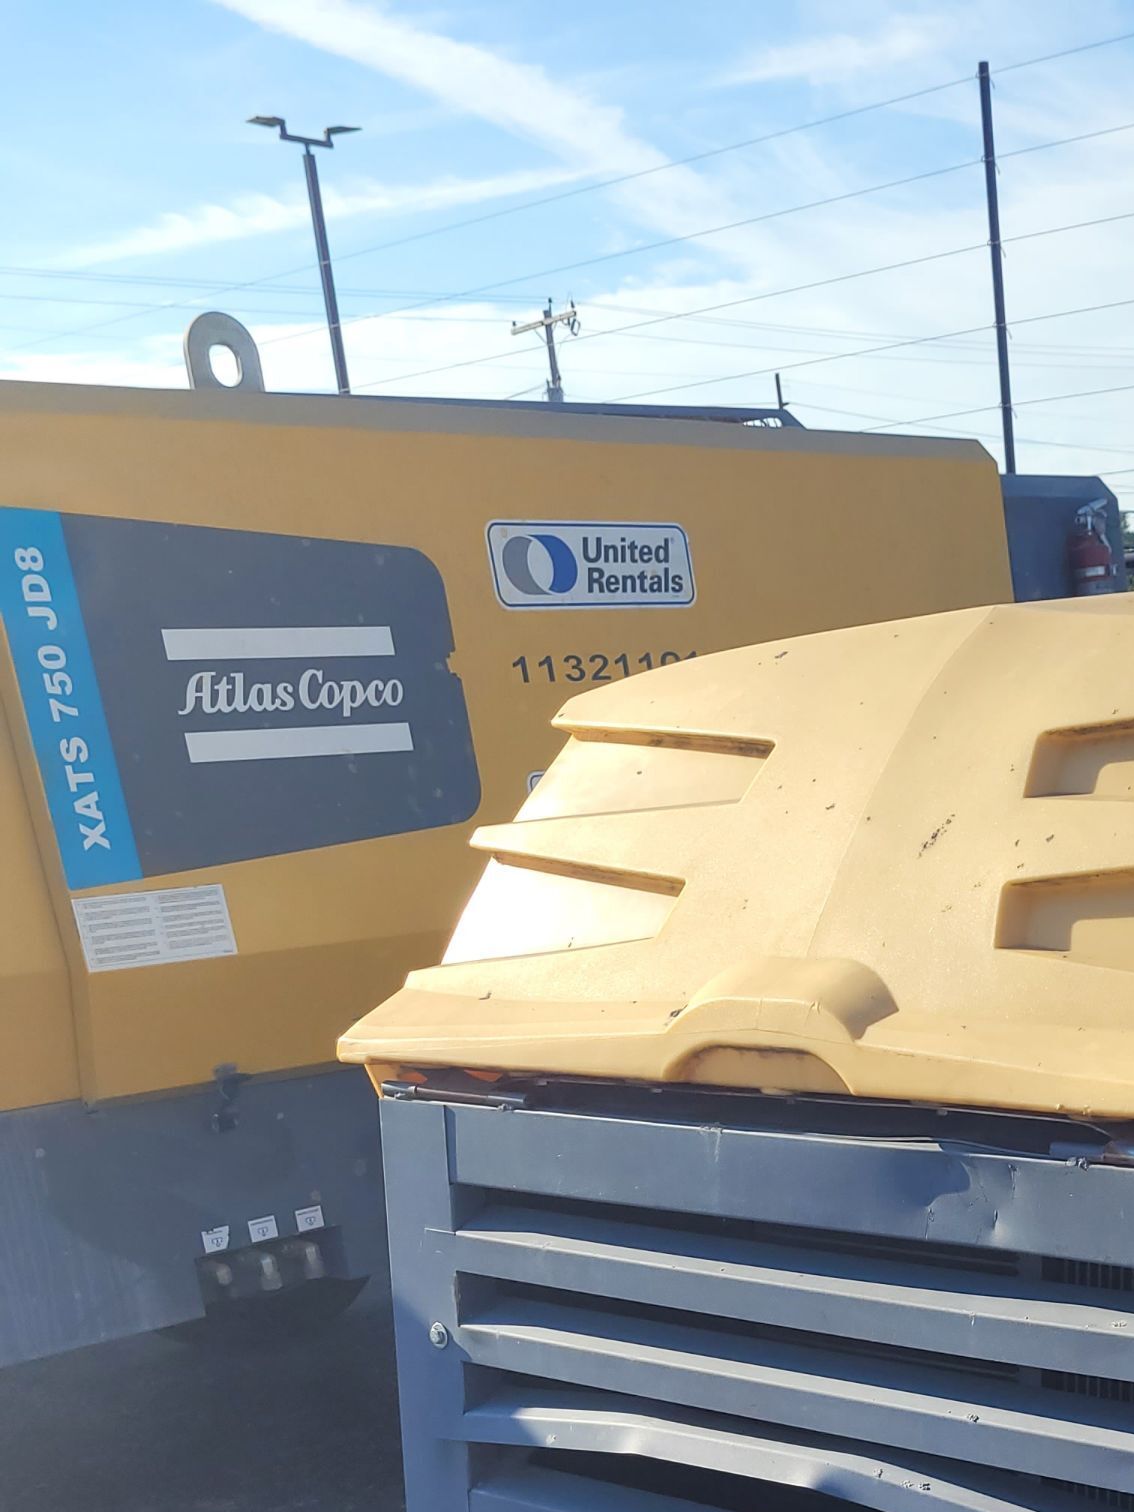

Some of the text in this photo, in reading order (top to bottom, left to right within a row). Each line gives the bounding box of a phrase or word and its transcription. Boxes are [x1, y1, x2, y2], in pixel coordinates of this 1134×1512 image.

[582, 537, 669, 563] United
[588, 567, 683, 593] Rentals
[512, 651, 697, 683] 113211
[14, 546, 111, 850] XATS 750 JD8
[178, 669, 403, 717] Atlas Copco
